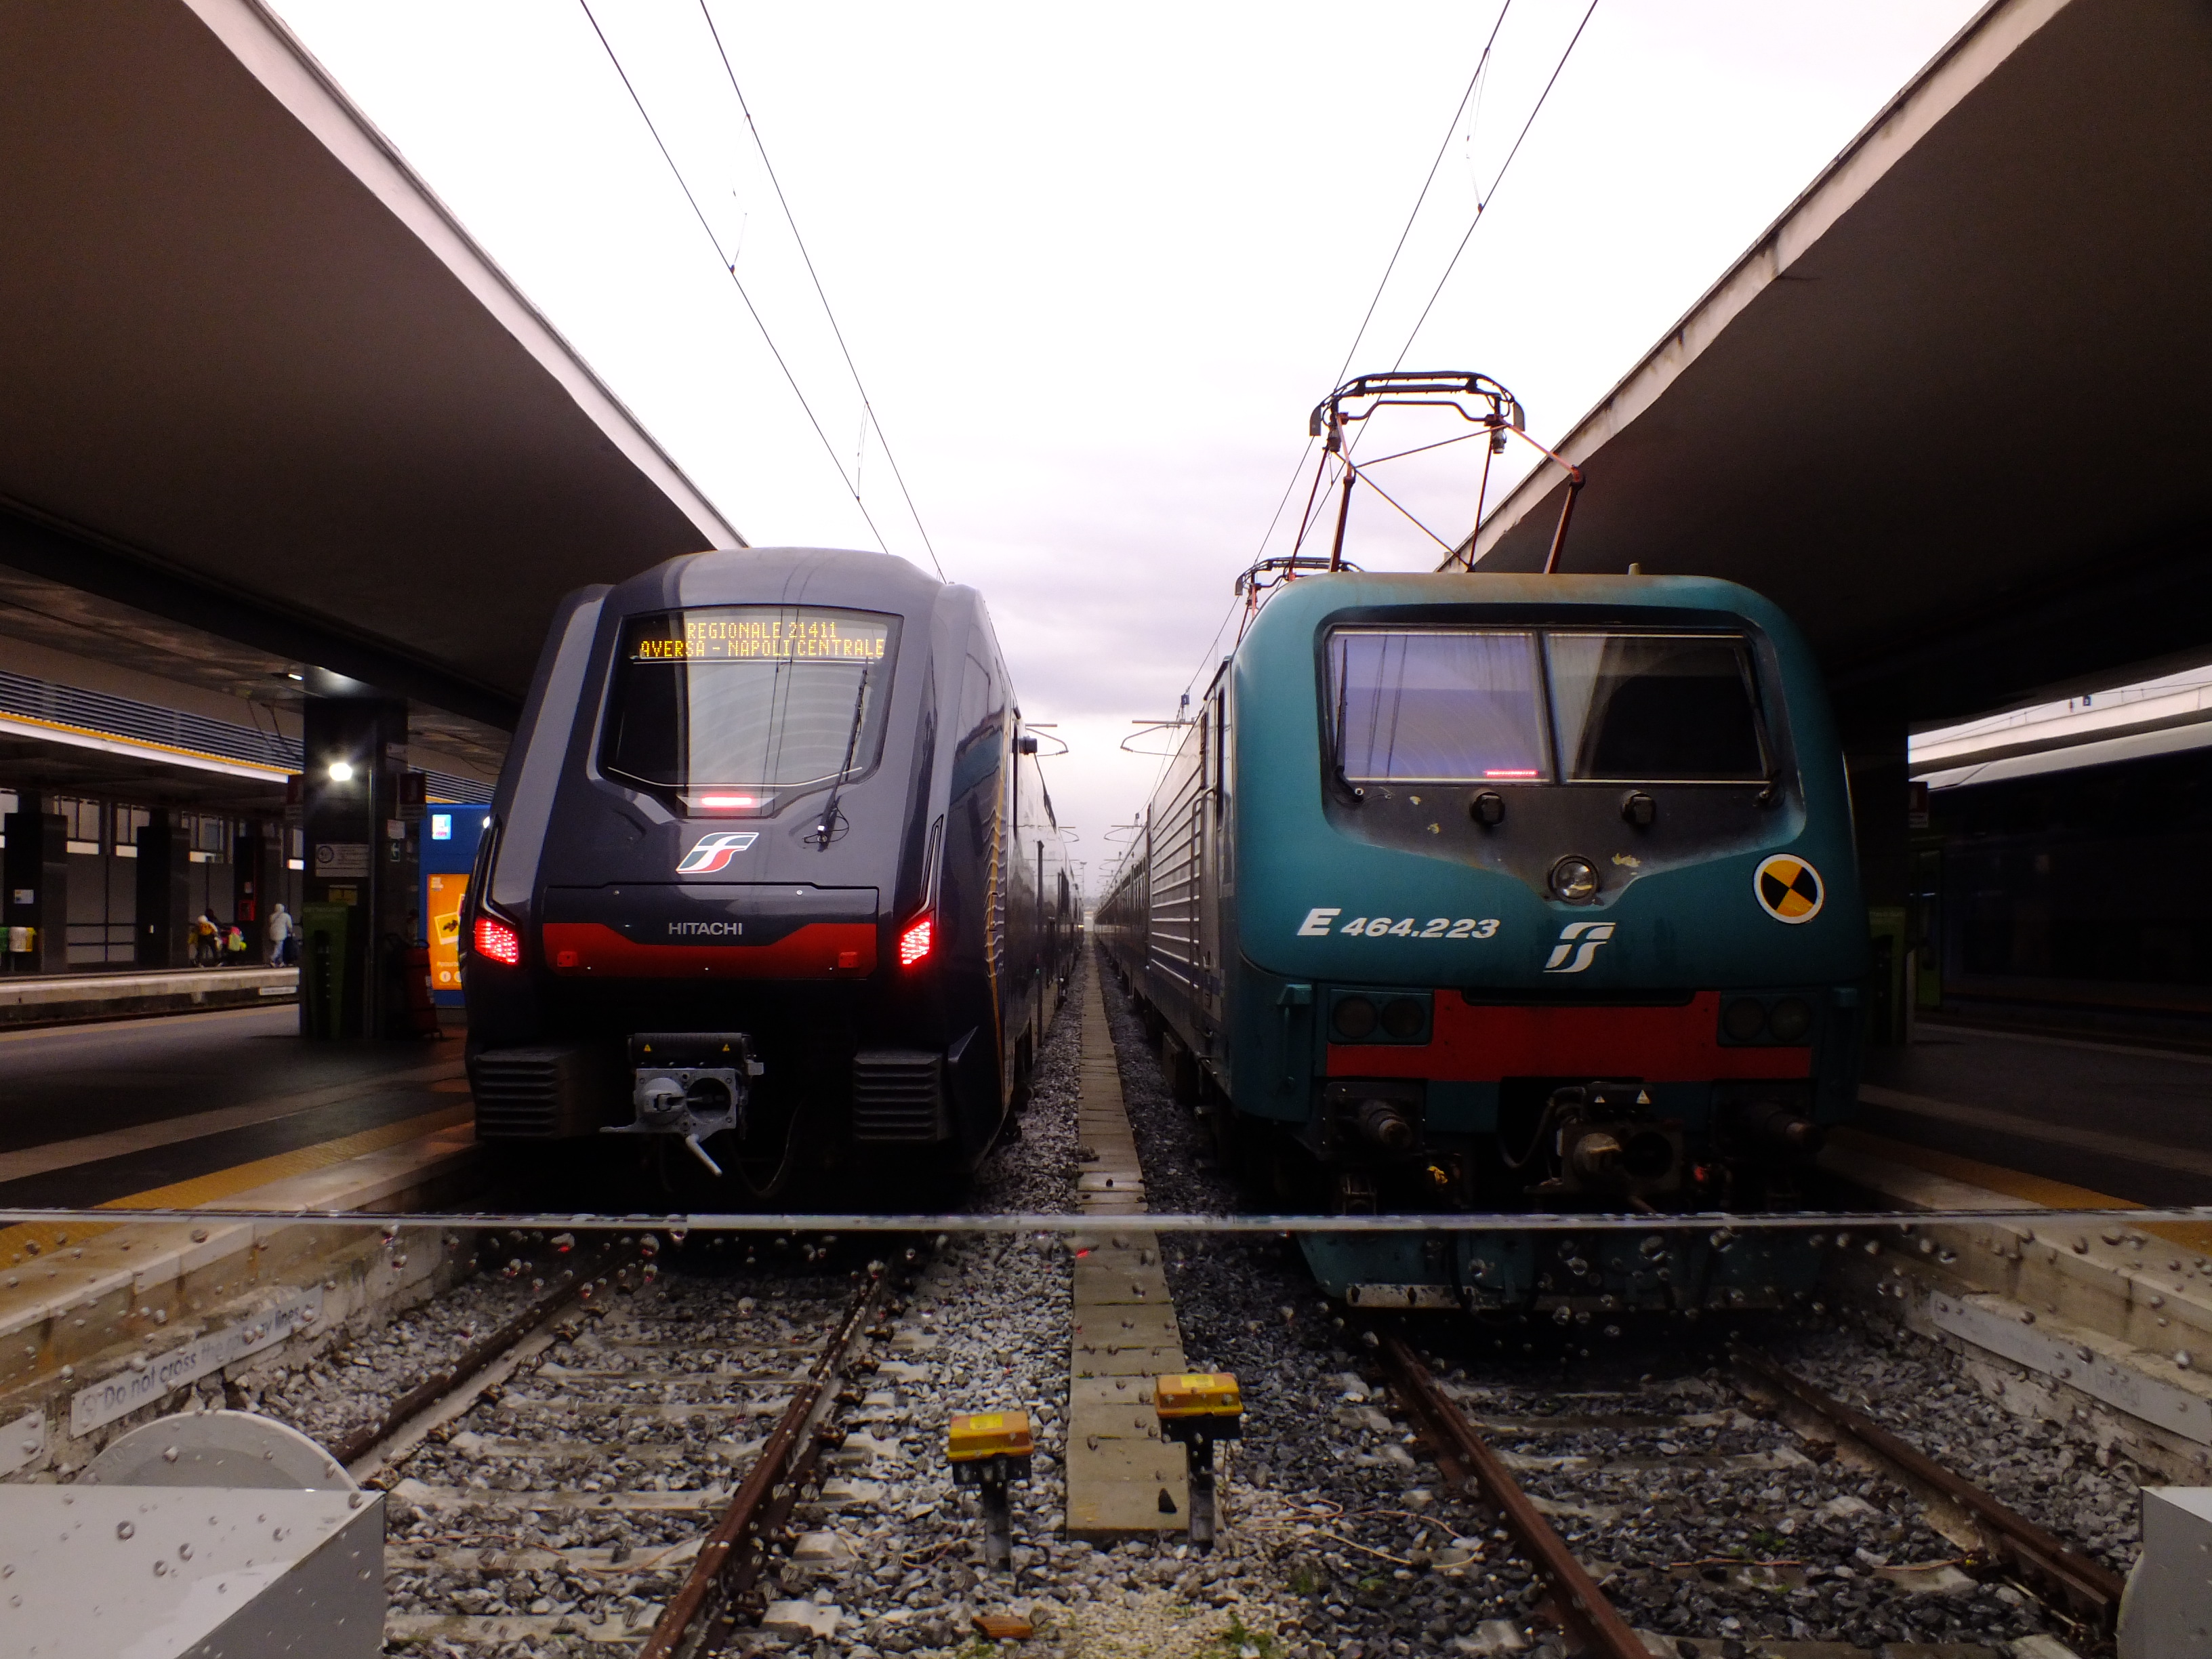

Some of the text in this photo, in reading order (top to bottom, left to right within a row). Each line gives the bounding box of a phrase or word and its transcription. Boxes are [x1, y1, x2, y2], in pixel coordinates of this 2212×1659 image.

[687, 621, 837, 640] REGIONALE 21411
[640, 640, 706, 658] AVERSA
[727, 639, 791, 657] NAPOLI
[797, 638, 885, 657] CENTRALE
[668, 922, 743, 935] HITACHI
[1296, 907, 1501, 939] E 464.223
[104, 1385, 127, 1410] Do
[159, 1353, 197, 1384] cross
